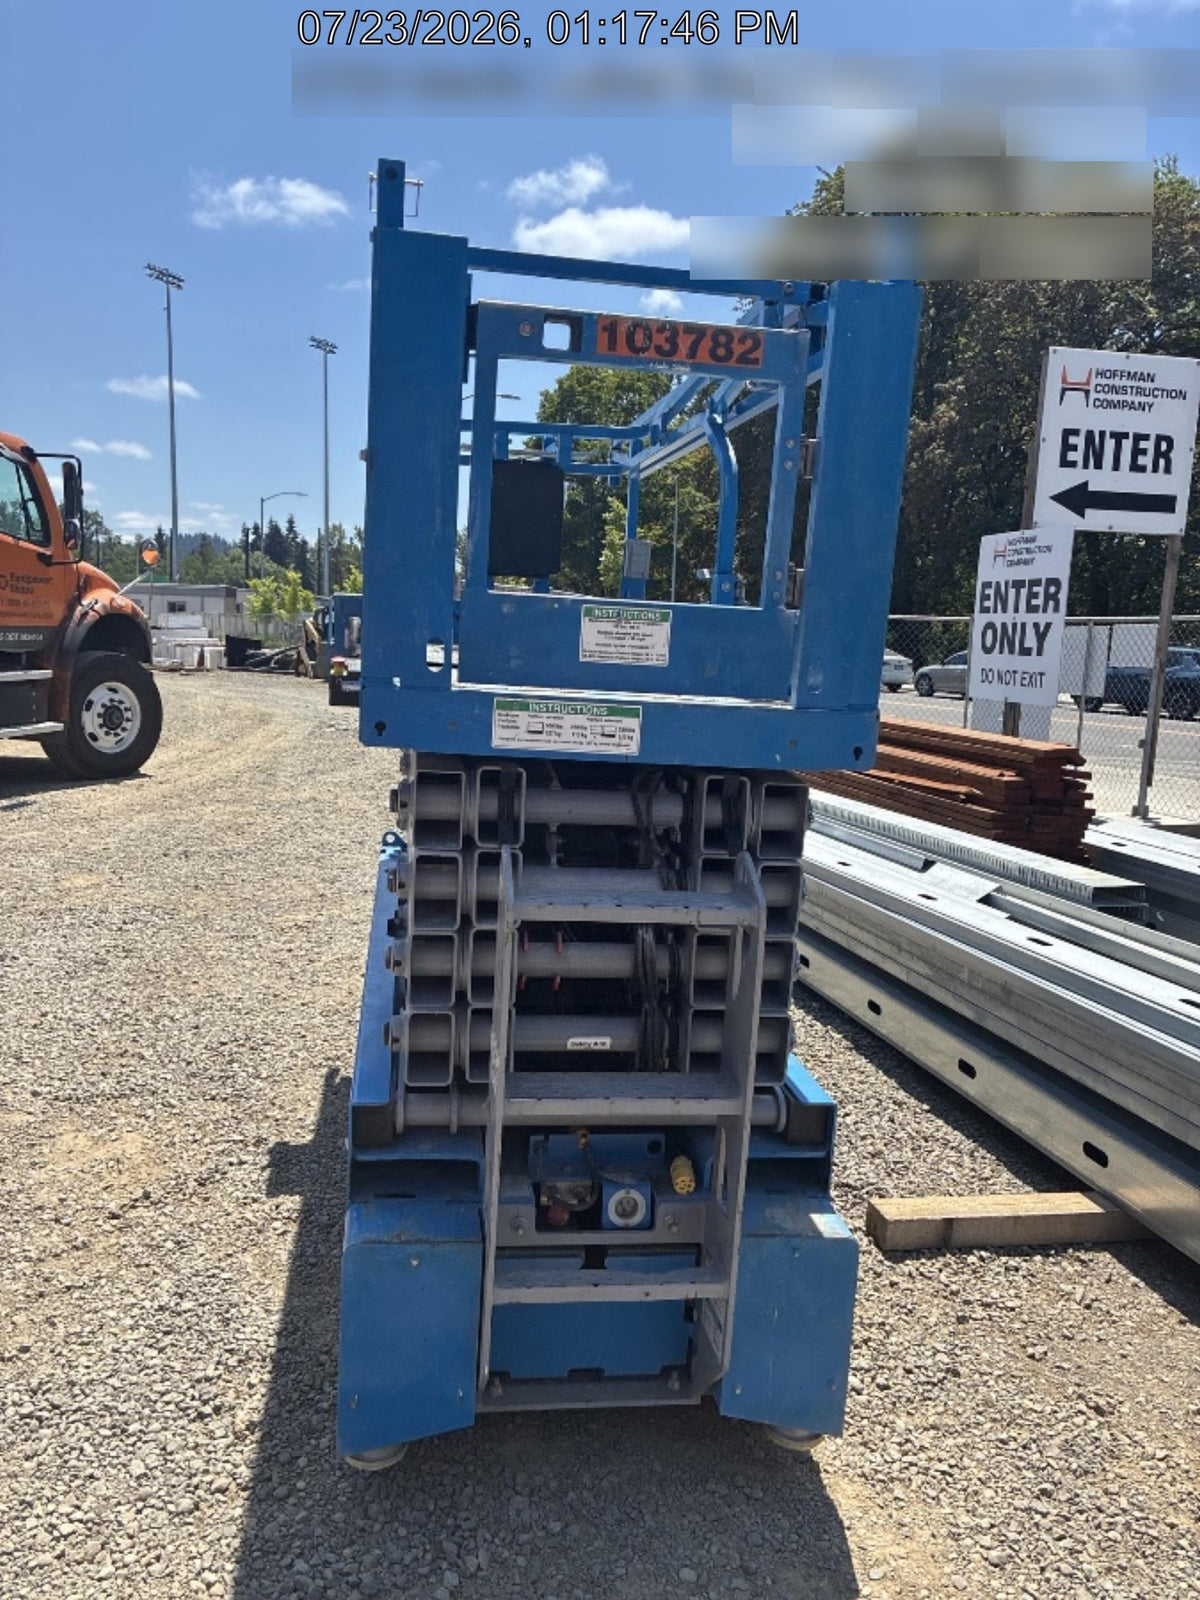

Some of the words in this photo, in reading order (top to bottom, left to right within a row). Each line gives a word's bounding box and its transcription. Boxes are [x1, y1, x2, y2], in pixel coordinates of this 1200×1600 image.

[602, 319, 762, 365] 103782
[1094, 368, 1156, 383] HOFFMAN
[1094, 383, 1187, 400] CONSTRUCTION
[1093, 398, 1154, 413] COMPANY
[1059, 428, 1174, 475] ENTER
[979, 577, 1062, 614] ENTER
[981, 621, 1053, 657] ONLY
[981, 668, 994, 684] DO
[997, 669, 1018, 687] NOT
[1020, 671, 1046, 688] EXIT
[529, 702, 609, 716] INSTRUCTIONS
